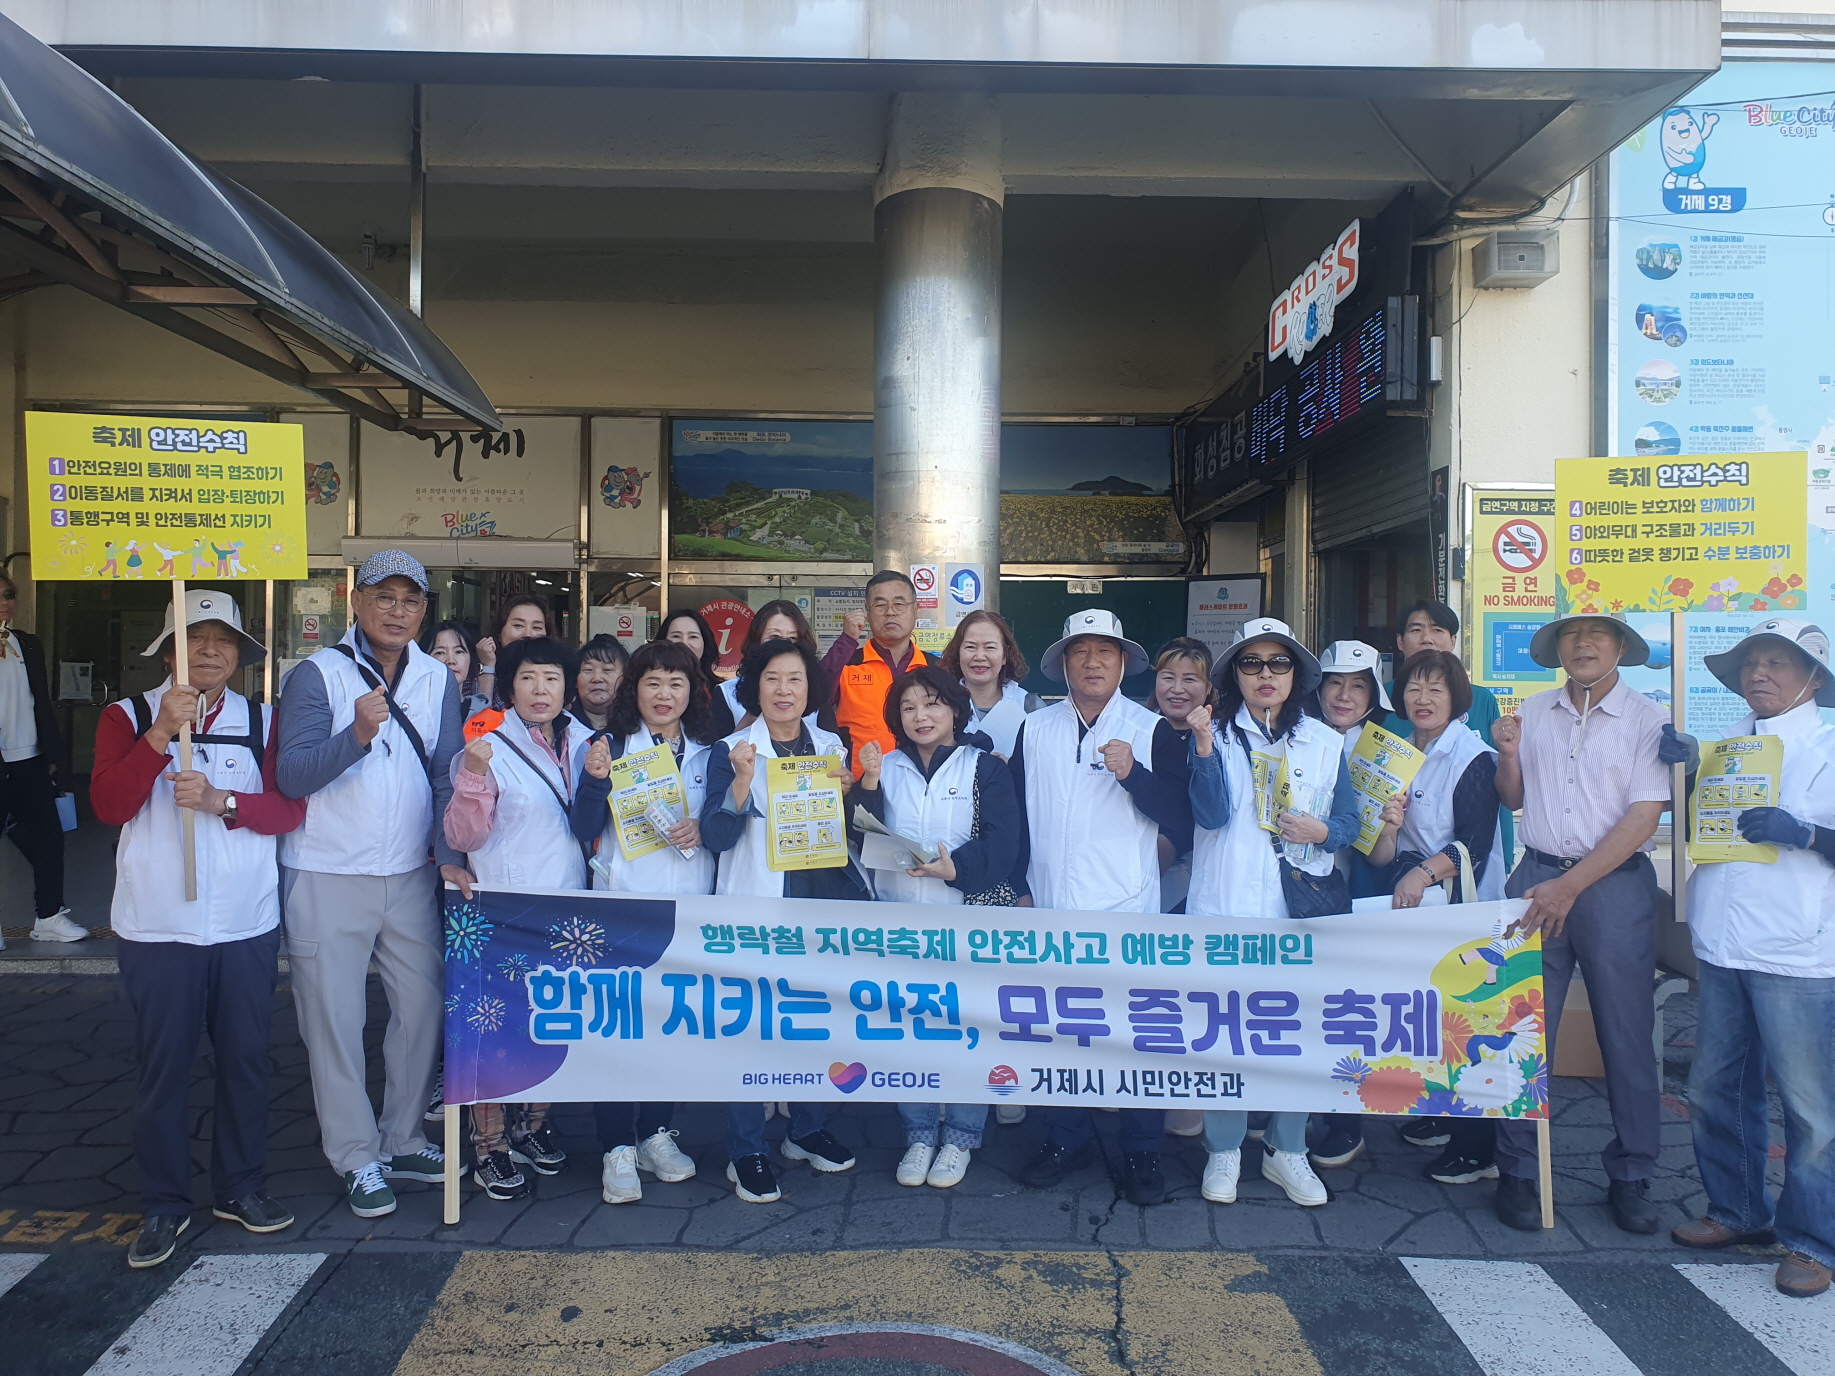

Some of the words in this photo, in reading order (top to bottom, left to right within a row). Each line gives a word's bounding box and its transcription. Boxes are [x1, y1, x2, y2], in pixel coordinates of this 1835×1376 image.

[1743, 103, 1794, 126] Blue
[1780, 126, 1818, 139] GEOJE
[1678, 195, 1704, 211] 거제
[1708, 195, 1732, 211] 9경
[1270, 228, 1357, 354] CROSS
[92, 425, 141, 448] 축제
[149, 426, 248, 454] 안전수칙
[1194, 408, 1247, 484] 화성침공
[66, 459, 143, 477] 안전요원의
[147, 461, 191, 479] 통제에
[195, 463, 224, 480] 적극
[228, 464, 283, 482] 협조하기
[1607, 467, 1651, 488] 축제
[1656, 461, 1749, 489] 안전수칙
[68, 484, 145, 503] 이동질서를
[149, 486, 193, 503] 지켜서
[197, 487, 285, 506] 입장·퇴장하기
[1481, 500, 1518, 512] 금연구역
[1520, 501, 1539, 512] 지정
[1584, 499, 1638, 517] 어린이는
[1641, 498, 1697, 515] 보호자와
[1699, 497, 1755, 514] 함께하기
[69, 509, 131, 528] 통행구역
[135, 511, 151, 528] 및
[154, 511, 227, 529] 안전통제선
[230, 512, 272, 529] 지키기
[441, 510, 479, 528] Blue
[449, 521, 478, 538] City
[1584, 523, 1638, 540] 야외무대
[1641, 522, 1696, 539] 구조물과
[1699, 520, 1755, 538] 거리두기
[1584, 547, 1624, 564] 따뜻한
[1627, 547, 1655, 563] 겉옷
[1658, 546, 1699, 563] 챙기고
[1702, 545, 1731, 562] 수분
[1734, 544, 1791, 560] 보충하기
[700, 601, 720, 616] 거제시
[721, 601, 751, 619] 관광안내소
[1484, 594, 1501, 607] NO
[1503, 594, 1556, 607] SMOKING
[918, 631, 953, 643] 금연정류소
[1372, 731, 1386, 743] 축제
[1385, 737, 1413, 760] 안전수칙
[1729, 741, 1763, 752] 안전수칙
[612, 761, 628, 772] 축제
[628, 751, 660, 767] 안전수칙
[780, 762, 796, 771] 축제
[797, 760, 828, 771] 안전수칙
[700, 922, 807, 956] 행락철
[816, 926, 956, 963] 지역축제
[966, 928, 1110, 966] 안전사고
[1120, 932, 1194, 966] 예방
[1203, 930, 1314, 966] 캠페인
[528, 970, 643, 1041] 함께
[661, 972, 832, 1042] 지키는
[849, 979, 980, 1051] 안전,
[997, 983, 1112, 1048] 모두
[1127, 987, 1303, 1057] 즐거운
[1321, 988, 1440, 1059] 축제
[742, 1072, 770, 1086] BIG
[771, 1072, 824, 1086] HEART
[870, 1070, 941, 1090] GEOJE
[1029, 1066, 1104, 1097] 거제시
[1115, 1068, 1246, 1100] 시민안전과
